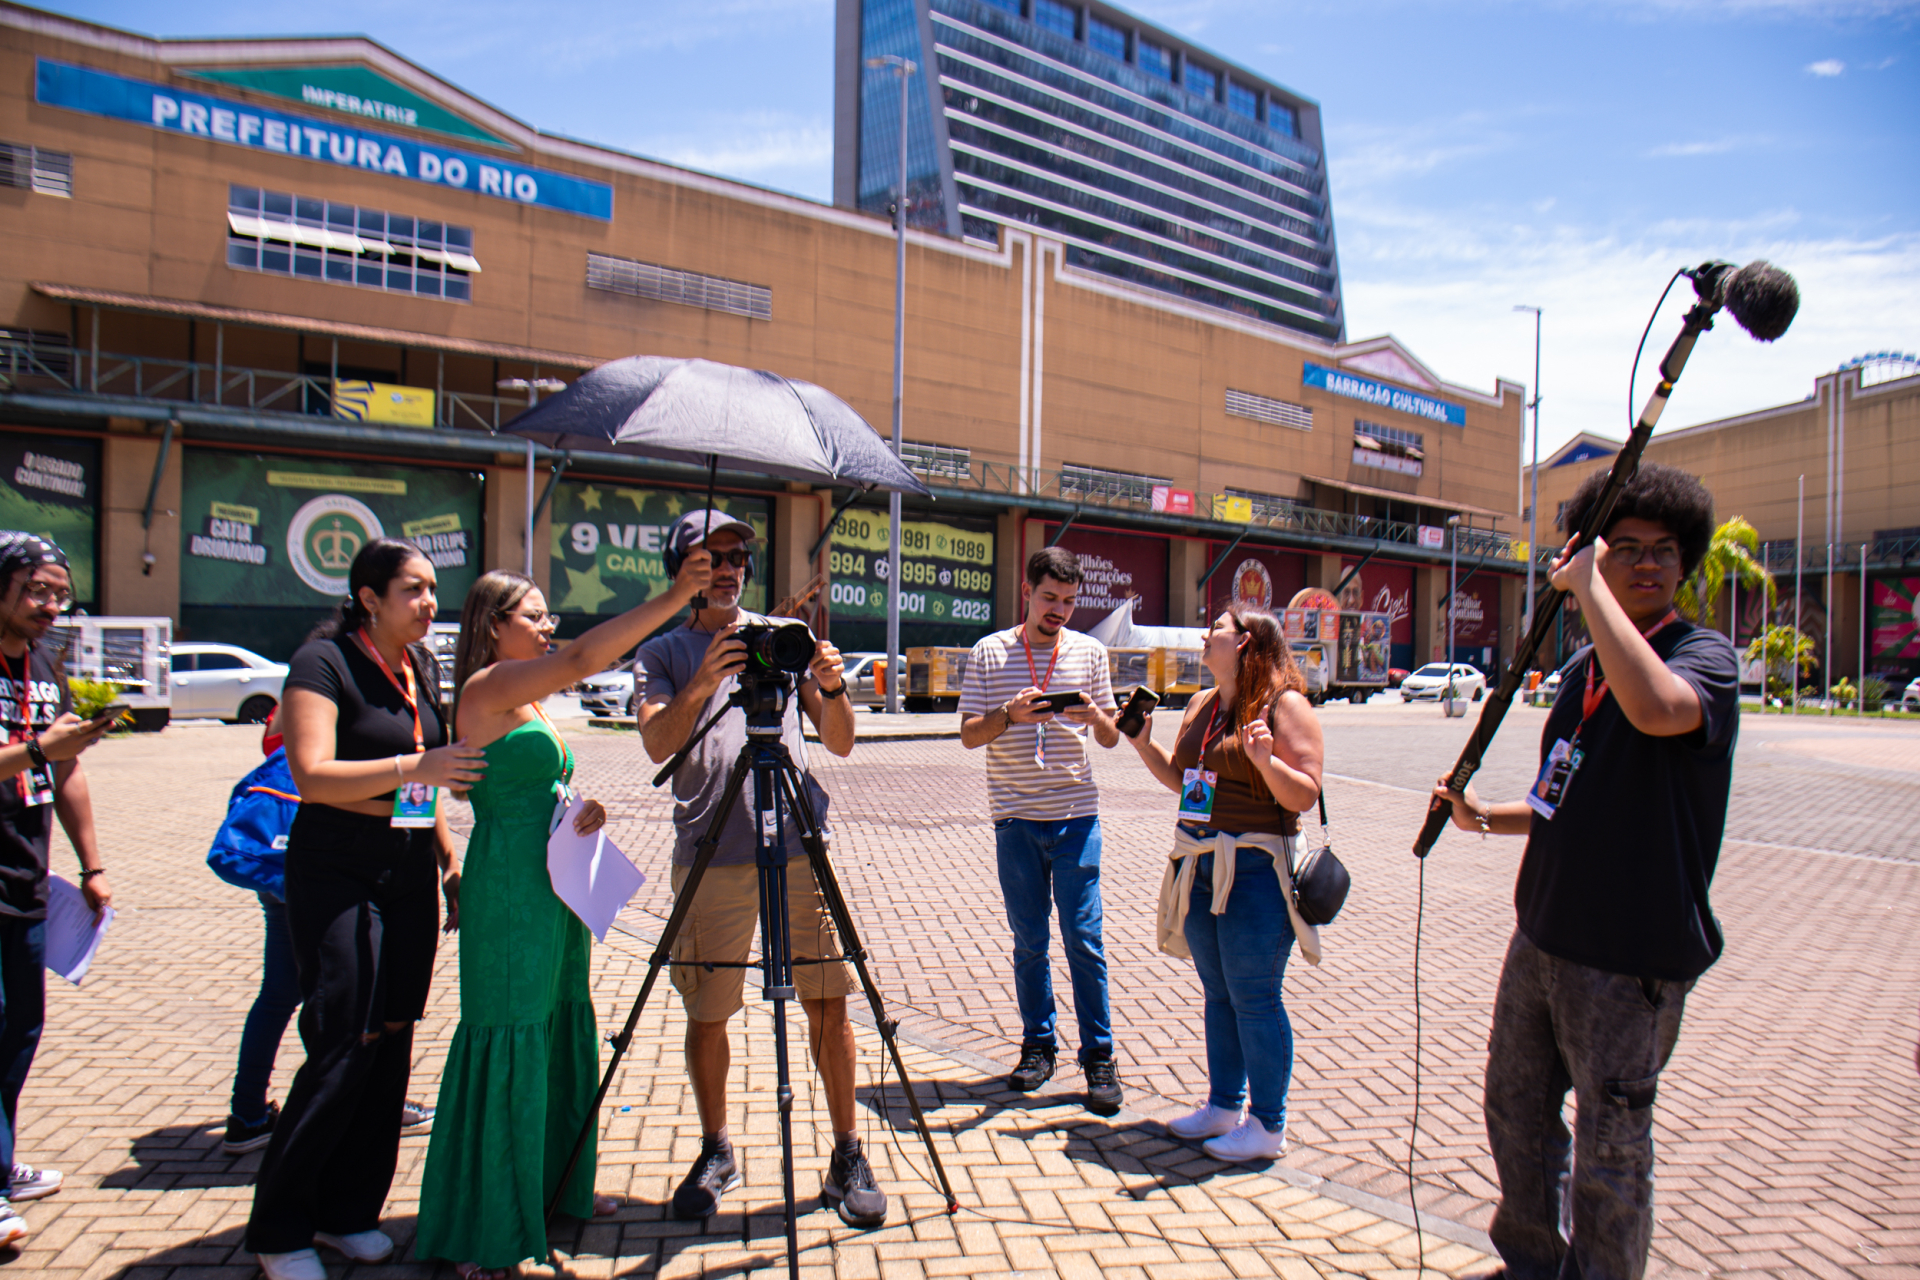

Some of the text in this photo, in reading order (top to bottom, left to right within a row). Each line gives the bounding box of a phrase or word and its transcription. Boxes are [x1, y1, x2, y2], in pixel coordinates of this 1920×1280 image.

[302, 84, 418, 127] IMPERATRIZ
[152, 94, 538, 202] PREFEITURA DO RIO
[1392, 391, 1448, 423] CULTURAL
[431, 531, 468, 553] FELIPE
[571, 521, 599, 555] 9
[832, 516, 985, 560] 980 981 1989
[830, 551, 992, 593] 994 995 1999
[1076, 553, 1114, 571] ilhões
[1080, 568, 1133, 588] orações
[830, 583, 991, 621] 000 001 2023
[1074, 593, 1143, 611] emocionr!
[1084, 583, 1108, 597] vou
